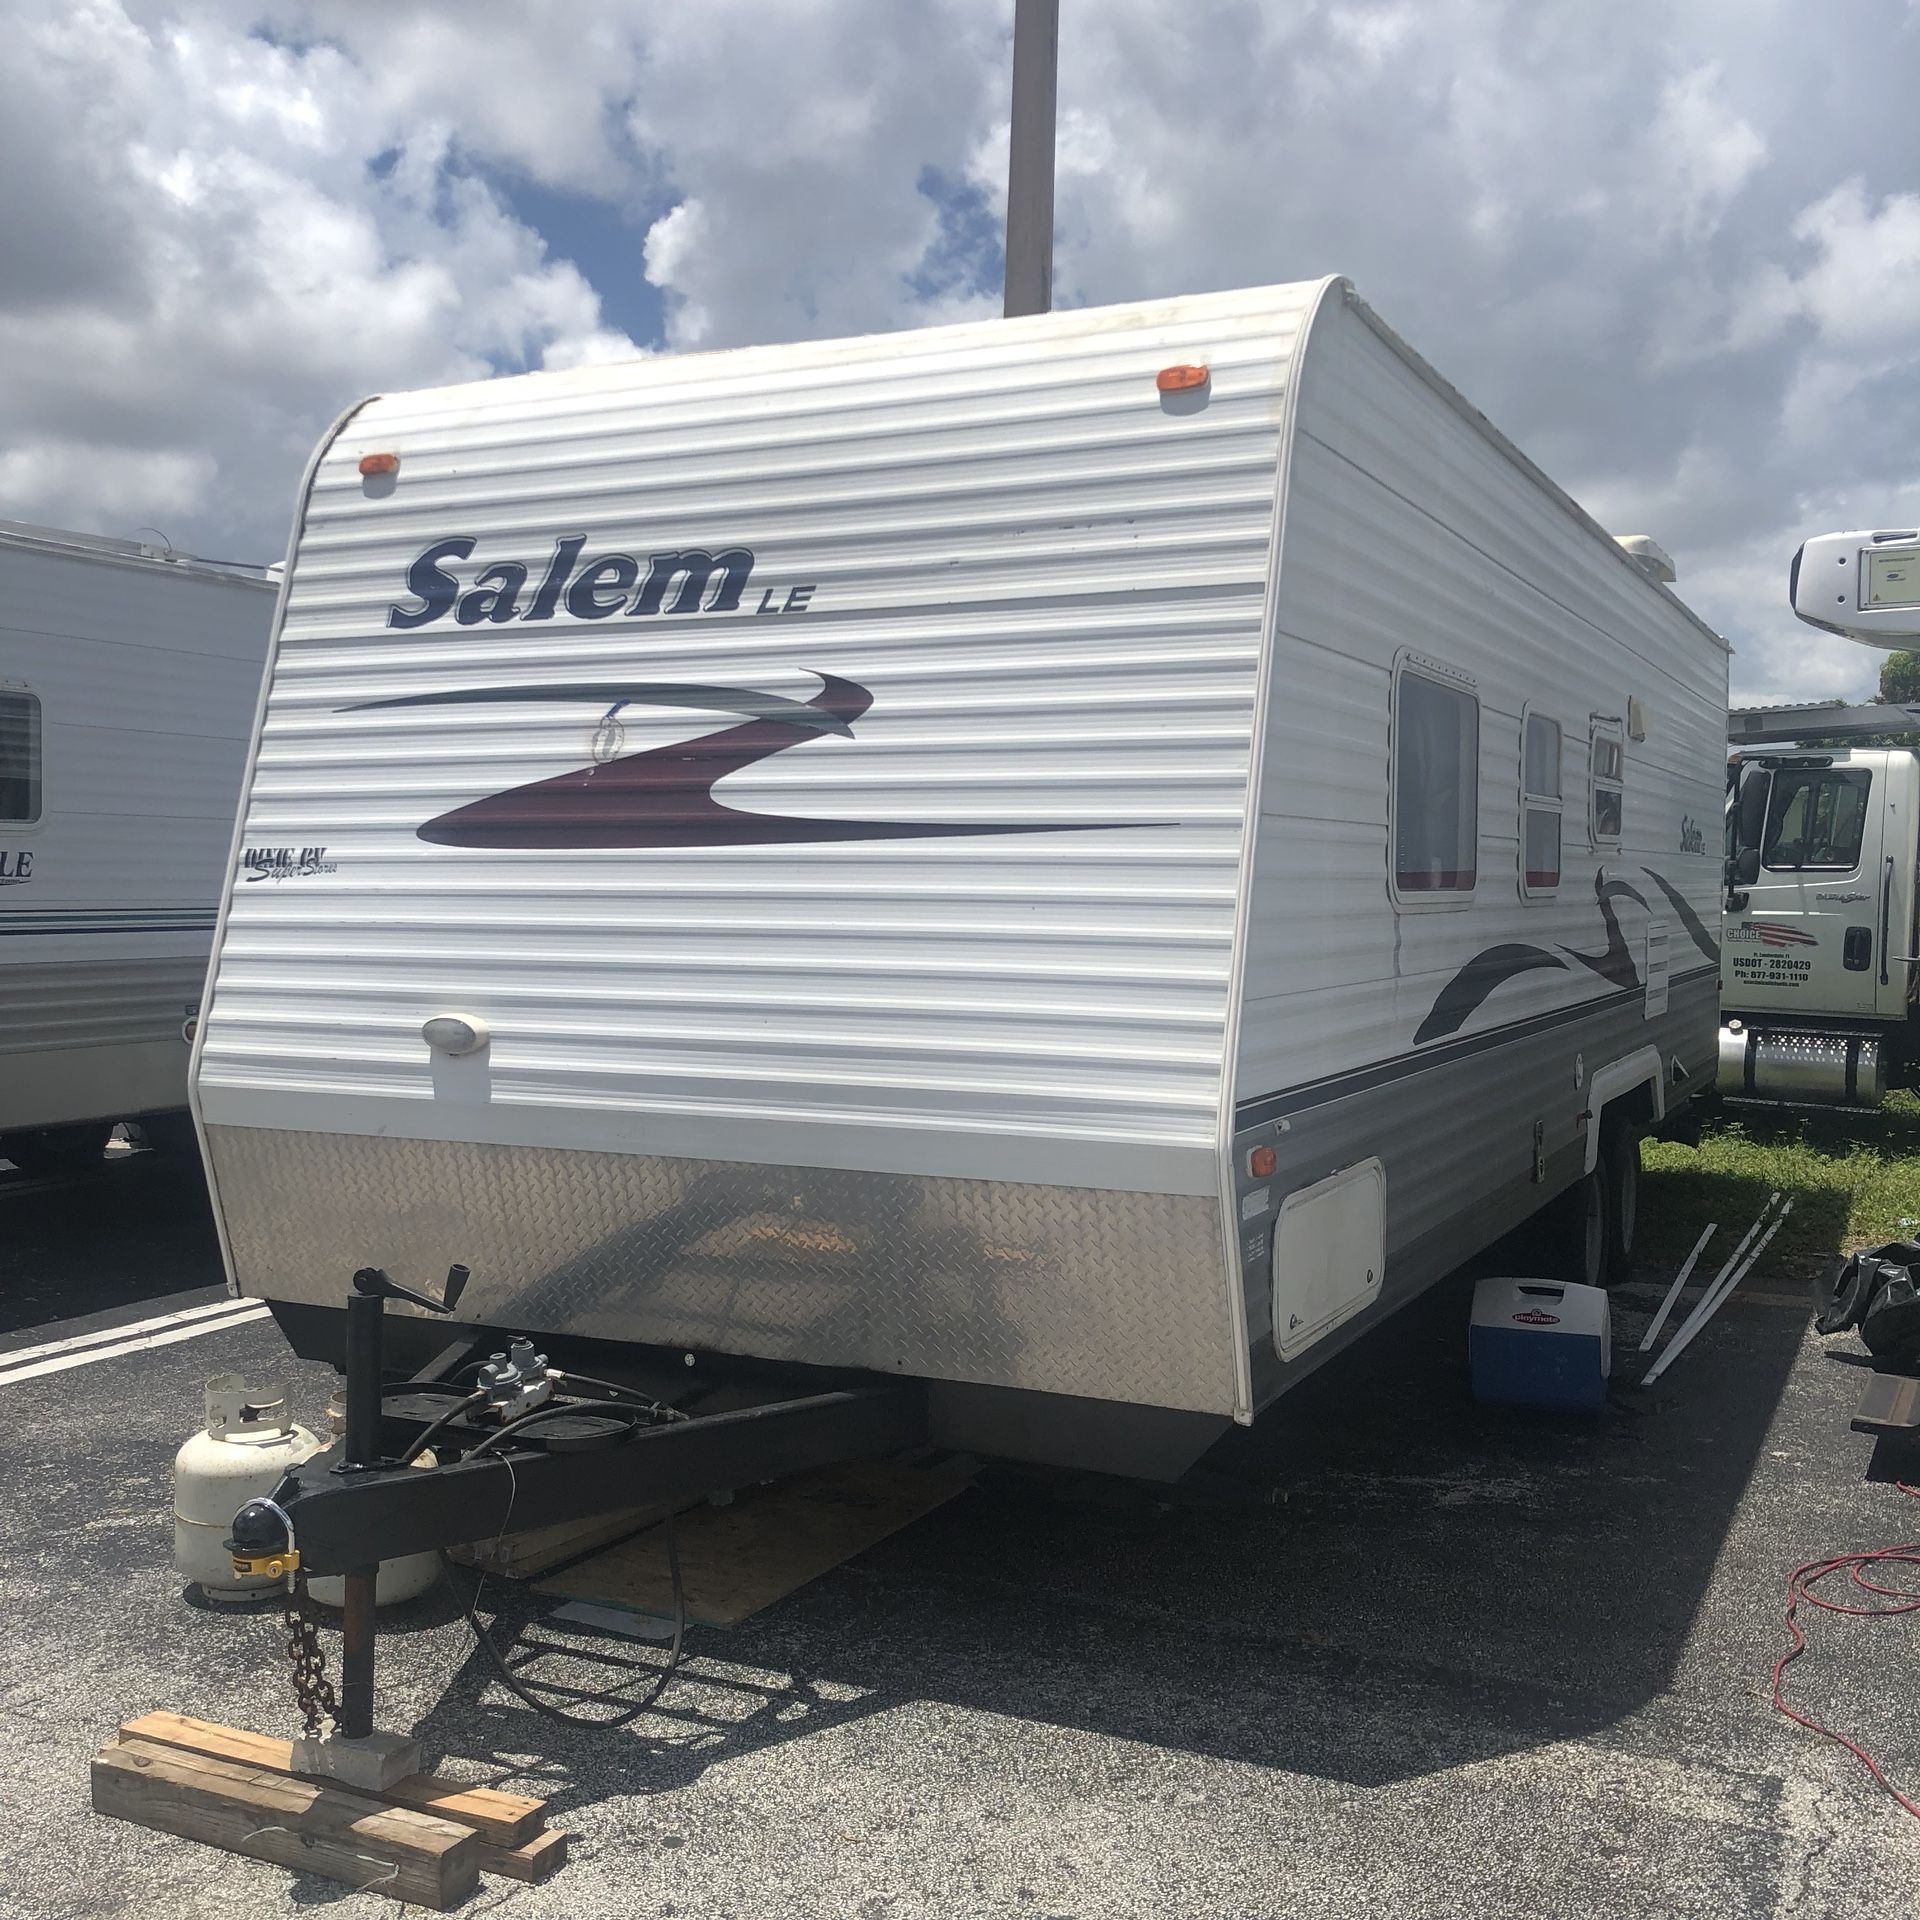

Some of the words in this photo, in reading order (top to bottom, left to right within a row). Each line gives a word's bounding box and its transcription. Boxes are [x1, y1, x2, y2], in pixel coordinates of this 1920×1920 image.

[386, 533, 755, 629] Salem
[756, 585, 817, 615] LE
[1727, 928, 1761, 939] CHOICE
[1733, 957, 1763, 968] USDOT
[1769, 959, 1812, 971] 2820429
[1735, 970, 1749, 979] Ph:
[1750, 971, 1809, 982] 877-931-1110
